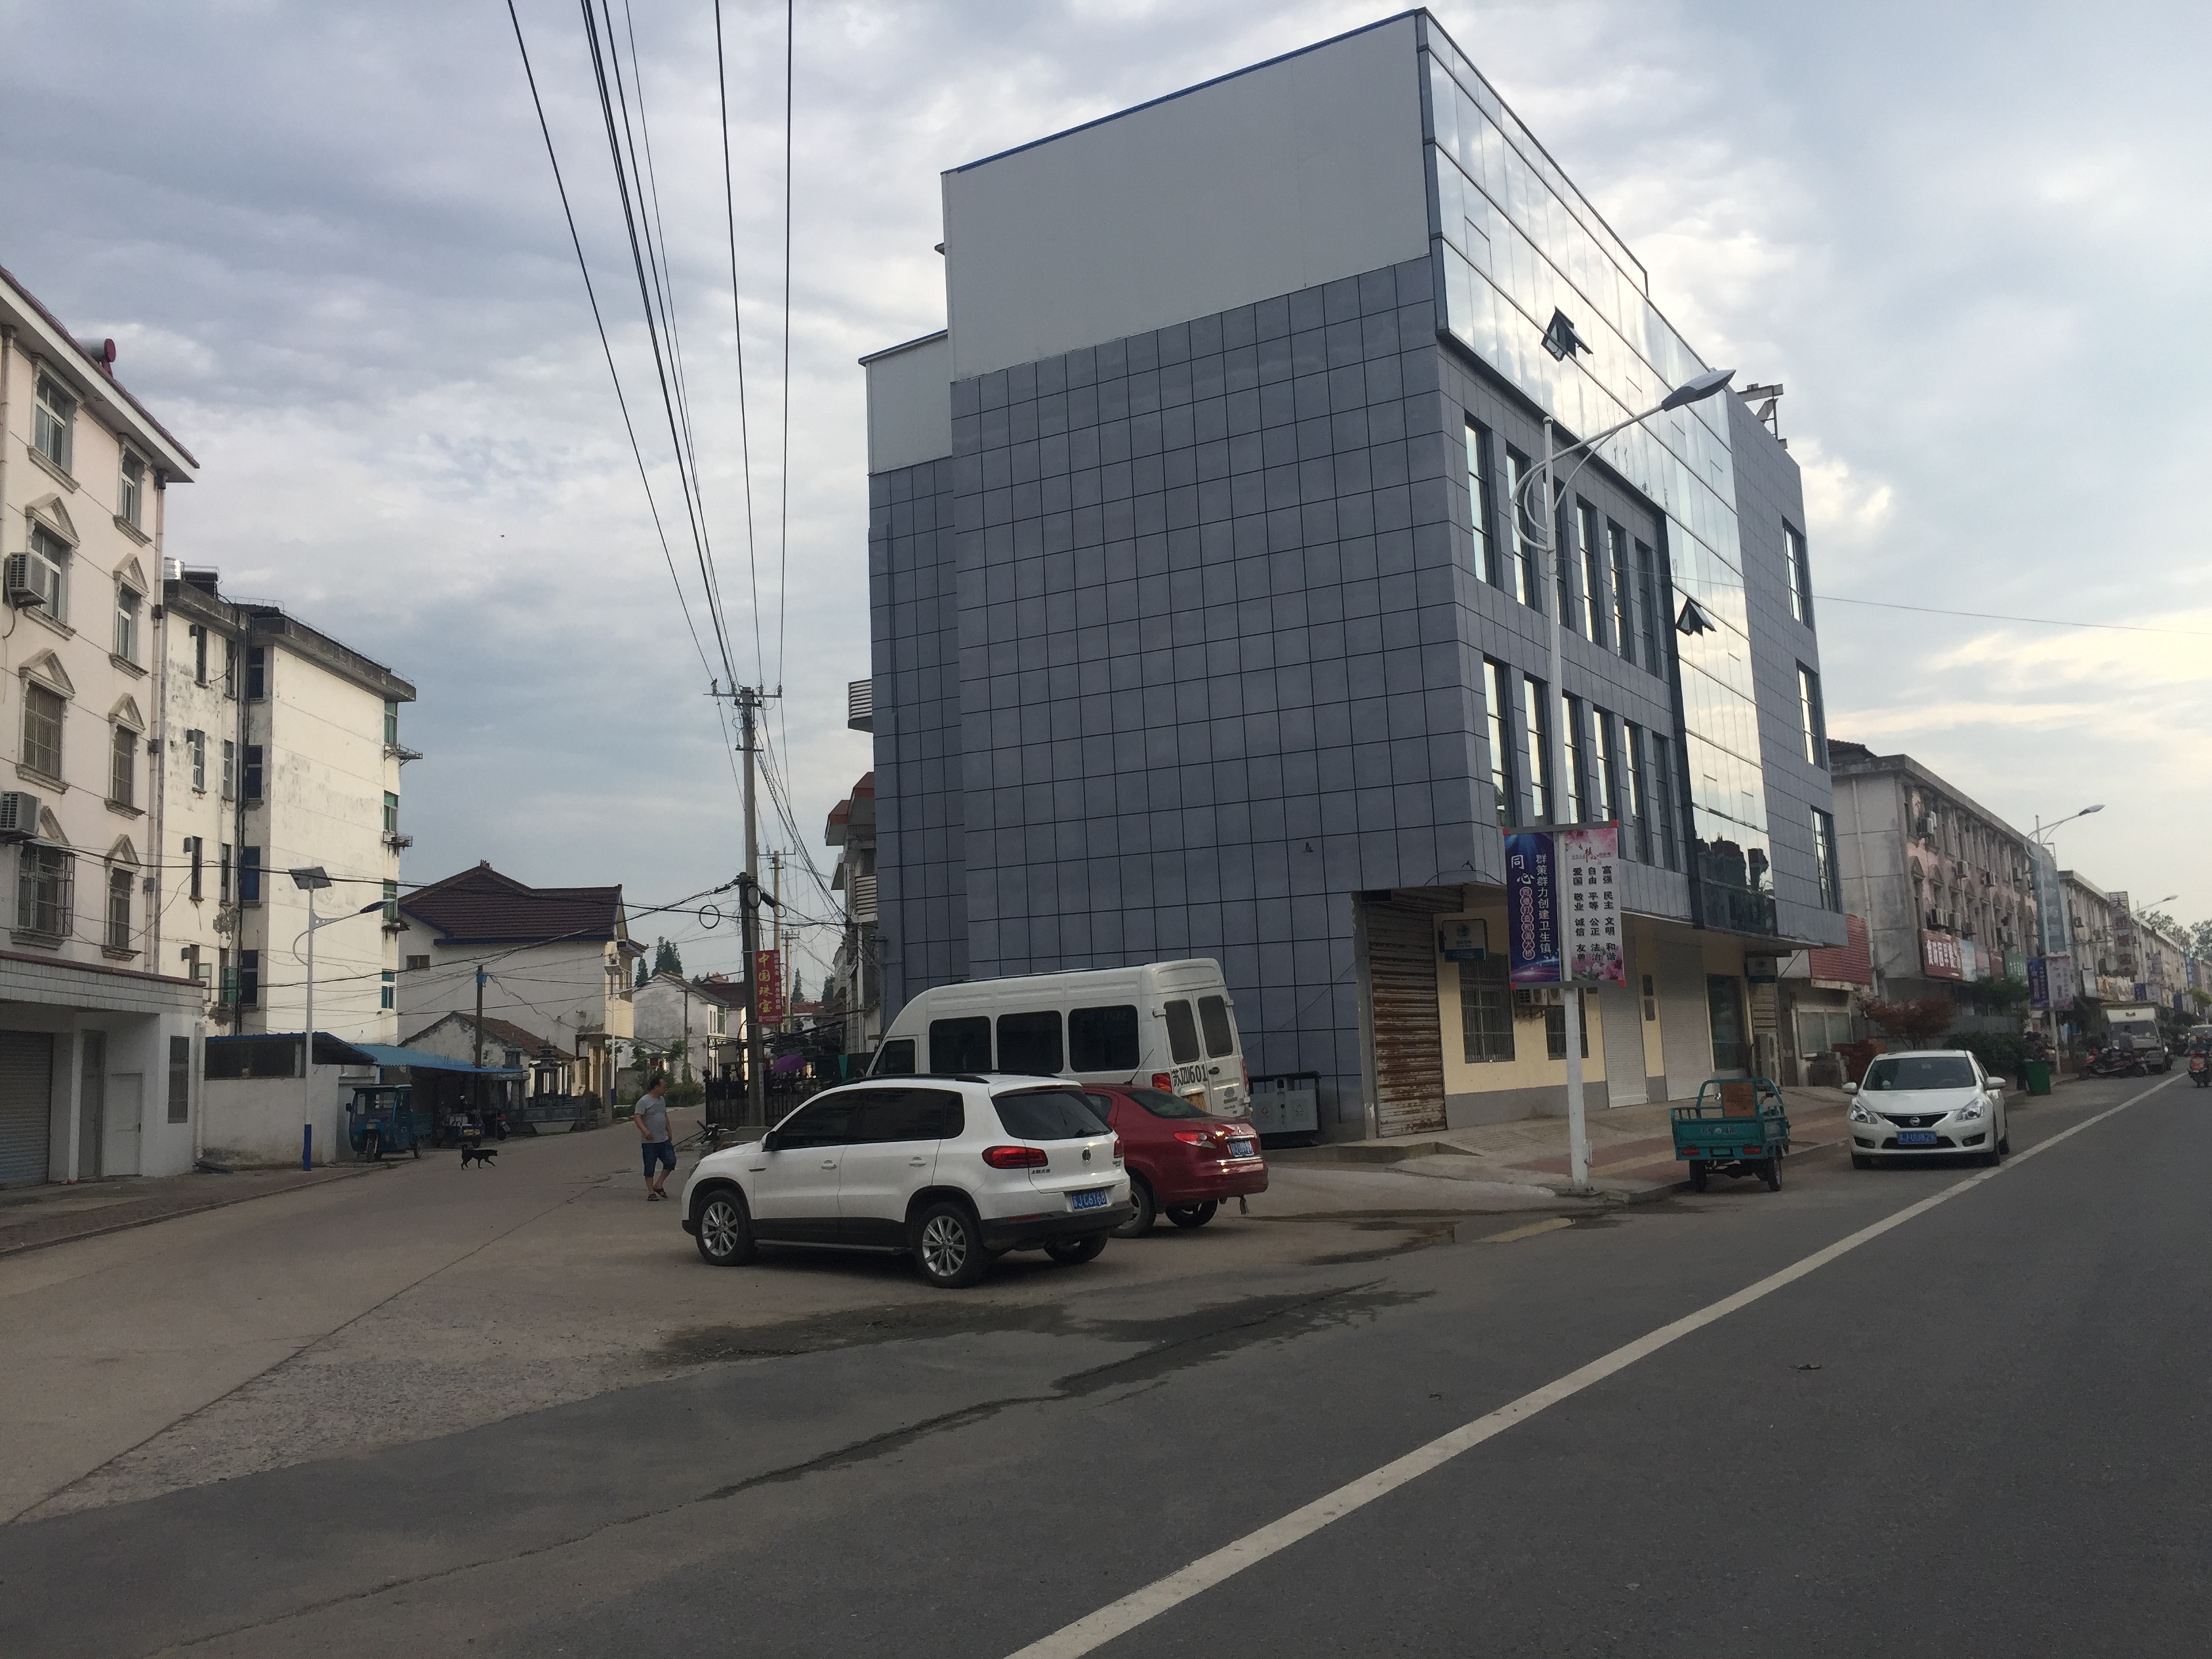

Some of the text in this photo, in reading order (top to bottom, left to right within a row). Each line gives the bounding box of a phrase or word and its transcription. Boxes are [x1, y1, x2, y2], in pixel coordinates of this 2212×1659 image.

[1511, 854, 1535, 884] 同心
[1572, 867, 1583, 886] 爱国
[1601, 865, 1613, 884] 富强
[1536, 853, 1552, 954] 群策群力创建卫生镇
[1574, 893, 1584, 911] 敬业
[1603, 891, 1614, 909] 民主
[1588, 866, 1601, 961] 自由 平等 公正 法治
[1574, 918, 1585, 937] 诚信
[1605, 916, 1616, 936] 文明
[1576, 943, 1586, 962] 友善
[1605, 943, 1616, 961] 和谐
[758, 952, 773, 1013] 中国珠宝
